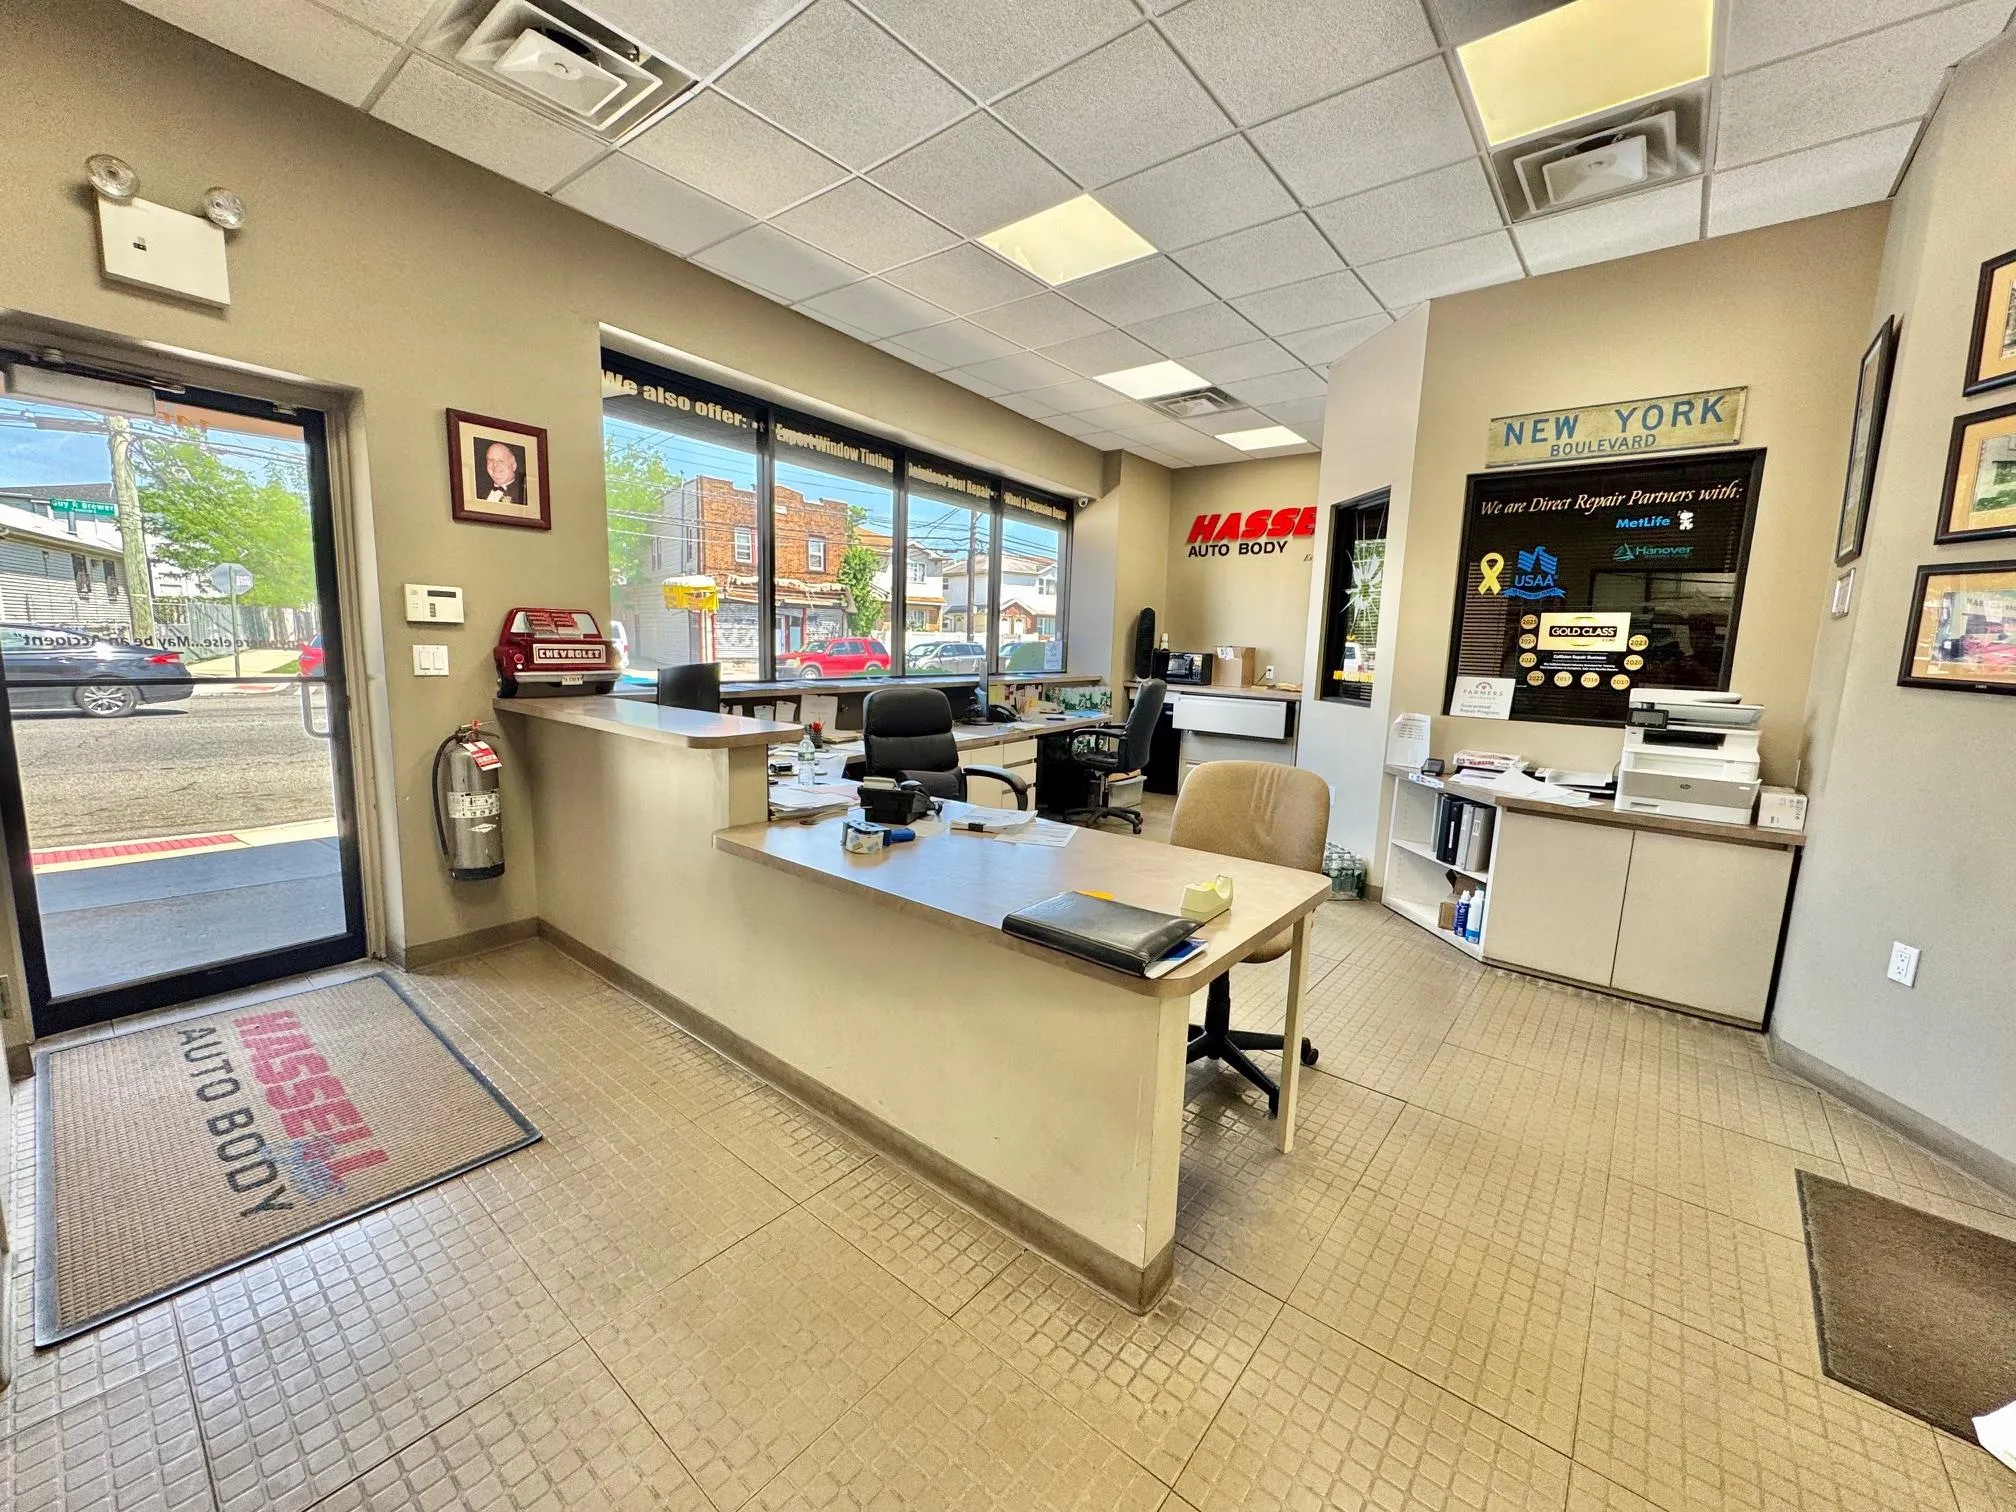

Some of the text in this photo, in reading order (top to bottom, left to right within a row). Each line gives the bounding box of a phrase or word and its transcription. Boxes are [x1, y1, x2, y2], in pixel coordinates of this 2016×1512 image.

[601, 369, 747, 429] We also offer:
[1503, 395, 1726, 447] NEW YORK
[1550, 434, 1657, 457] BOULEVARD
[815, 434, 858, 461] Window
[860, 448, 894, 473] Tinting
[967, 479, 991, 499] Repair
[52, 499, 68, 508] Guy
[81, 503, 114, 511] Brewer
[1480, 479, 1743, 516] We are Direct Repair Partners with:
[1615, 515, 1672, 529] MetLife
[1188, 541, 1288, 558] AUTO BODY
[1634, 545, 1695, 556] Hanover
[1514, 575, 1554, 587] USAA
[1551, 627, 1617, 637] GOLD CLASS
[539, 649, 601, 659] CHEVROLET
[1612, 678, 1629, 686] 2019
[1463, 688, 1504, 696] FARMERS
[177, 1026, 295, 1218] AUTO BODY
